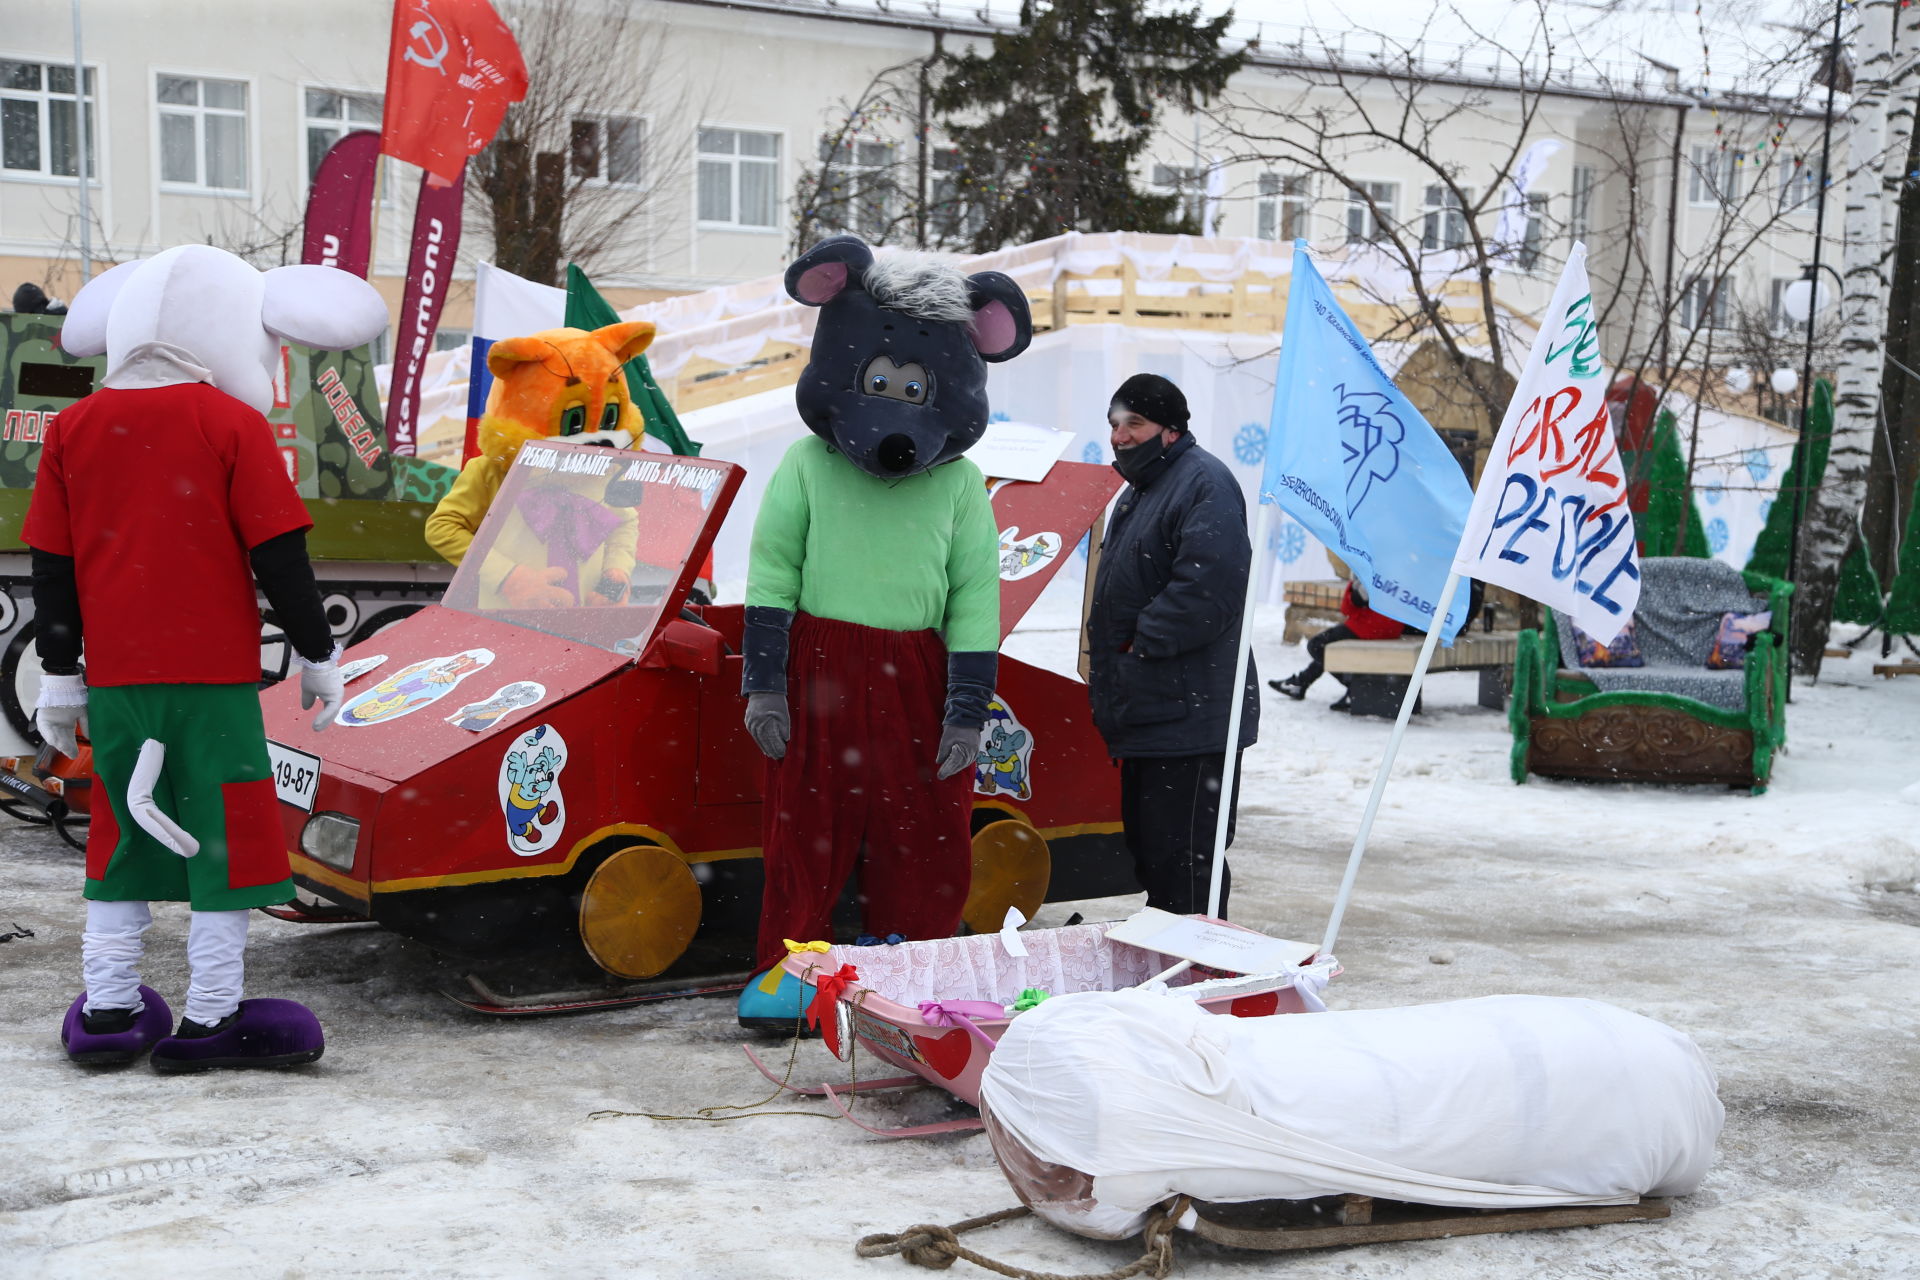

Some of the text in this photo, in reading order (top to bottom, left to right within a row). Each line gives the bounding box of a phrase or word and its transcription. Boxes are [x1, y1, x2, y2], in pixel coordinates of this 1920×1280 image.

[317, 366, 382, 469] ПОБЕДА
[625, 459, 661, 483] ЖИТЬ
[276, 760, 314, 796] 19-87
